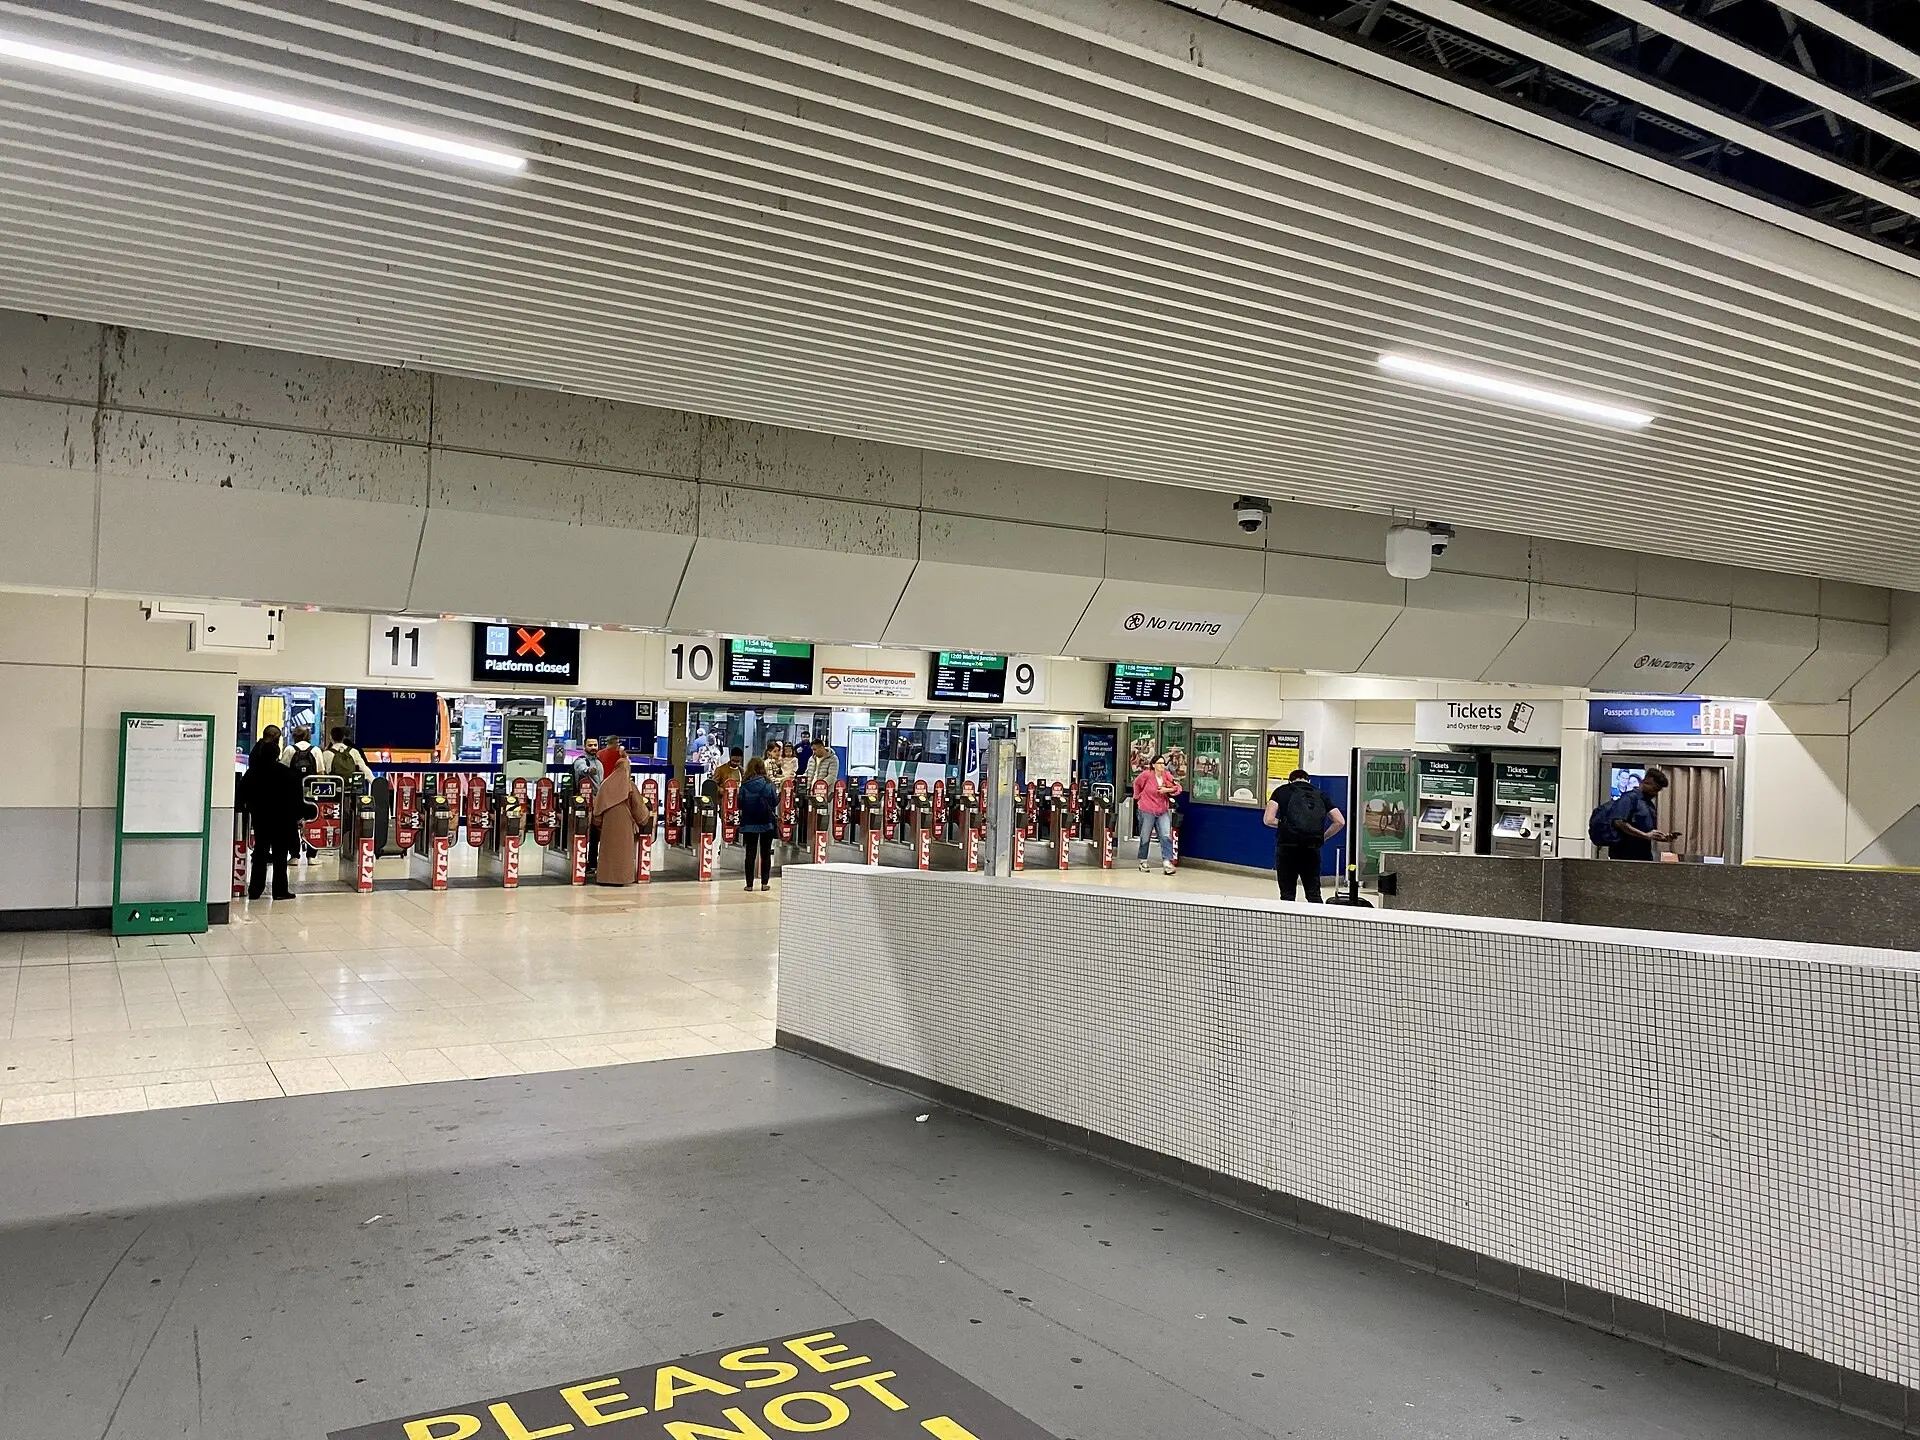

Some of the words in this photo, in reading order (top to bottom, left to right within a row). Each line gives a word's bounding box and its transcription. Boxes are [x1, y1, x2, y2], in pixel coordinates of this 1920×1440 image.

[1146, 617, 1167, 629] No
[1168, 620, 1221, 635] running
[385, 626, 419, 667] 11
[491, 641, 503, 652] 11
[671, 643, 713, 681] 10
[486, 659, 533, 672] Platform
[535, 662, 570, 674] closed
[869, 677, 907, 685] Overground
[1016, 663, 1034, 695] 9
[1648, 658, 1662, 668] No
[1661, 660, 1695, 672] running
[1447, 702, 1502, 718] Tickets
[1604, 708, 1632, 717] Passport
[1634, 708, 1640, 716] &
[1641, 708, 1648, 716] ID
[1650, 708, 1675, 717] Photos
[1458, 723, 1478, 731] Oyster
[1480, 723, 1501, 731] top-up
[362, 843, 374, 883] KFC
[437, 842, 448, 881] KFC
[508, 840, 520, 879] KFC
[576, 840, 587, 877] KFC
[641, 839, 651, 876] KFC
[704, 838, 713, 873] KFC
[870, 834, 880, 866] KFC
[921, 833, 930, 866] KFC
[970, 832, 979, 864] KFC
[1017, 832, 1025, 863] KFC
[1062, 832, 1070, 863] KFC
[234, 845, 246, 886] KFC
[402, 1332, 872, 1440] PLEASE
[662, 1370, 910, 1440] NOT
